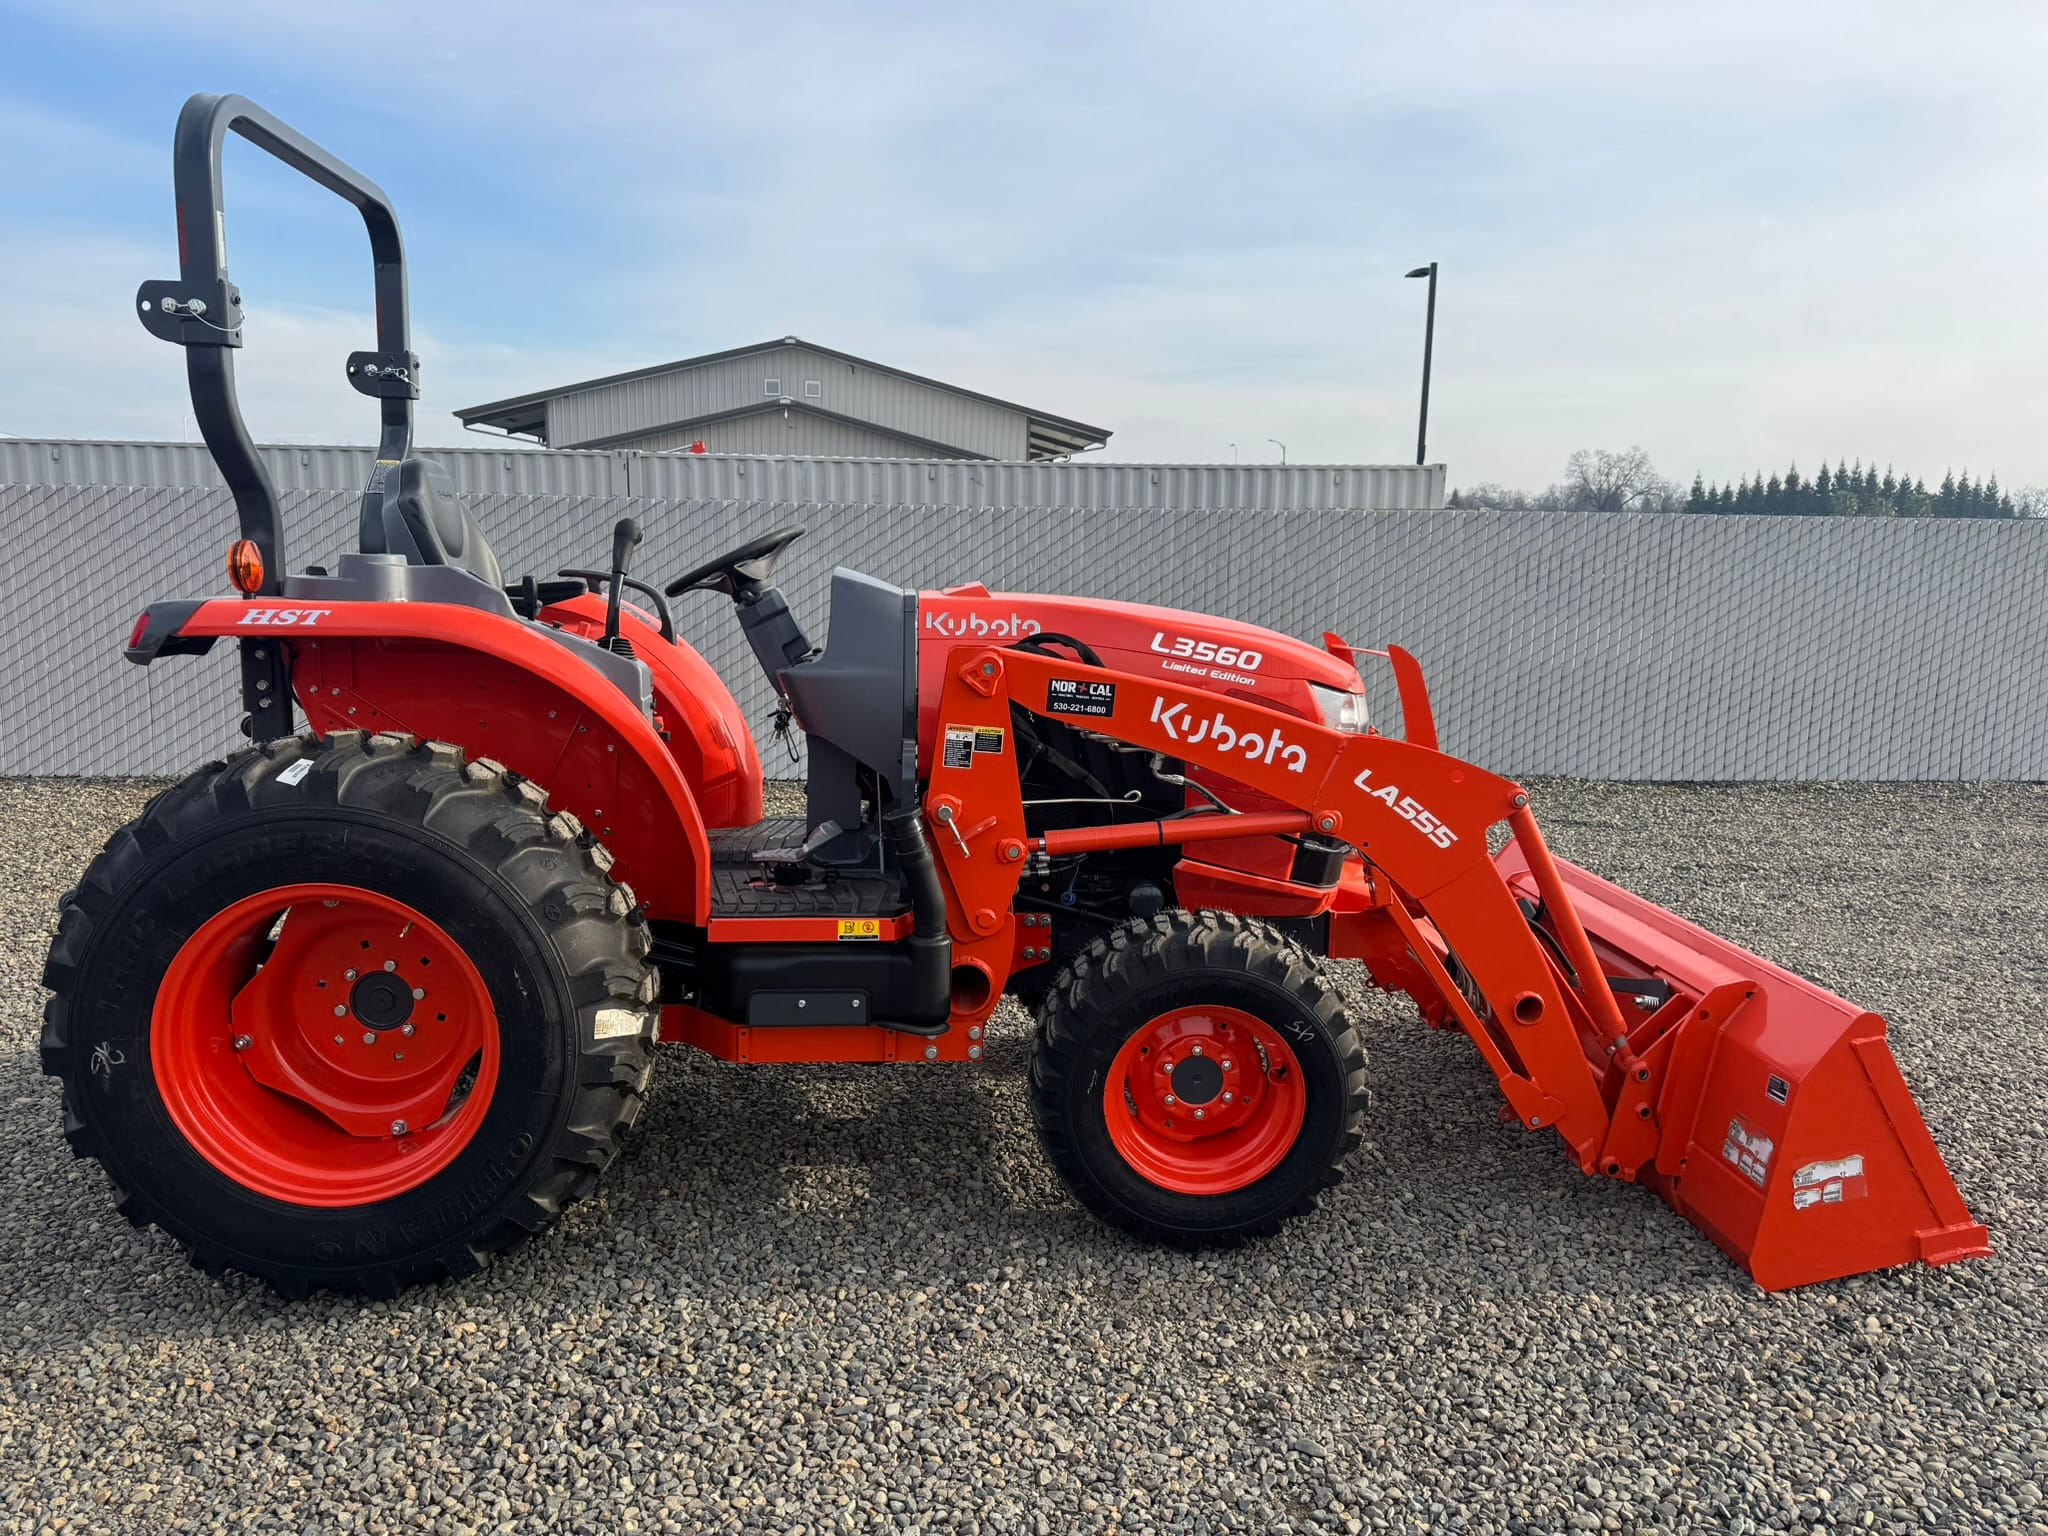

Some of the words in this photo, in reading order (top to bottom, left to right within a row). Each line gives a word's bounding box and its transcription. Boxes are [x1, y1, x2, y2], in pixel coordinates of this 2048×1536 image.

[238, 608, 332, 626] HST
[926, 611, 1042, 636] Kubota
[1151, 632, 1263, 670] L3560
[1162, 660, 1208, 676] Limited
[1210, 669, 1256, 686] Edition
[1053, 702, 1106, 714] 530-221-6800
[1150, 696, 1307, 774] Kubota
[1353, 768, 1457, 849] LA555
